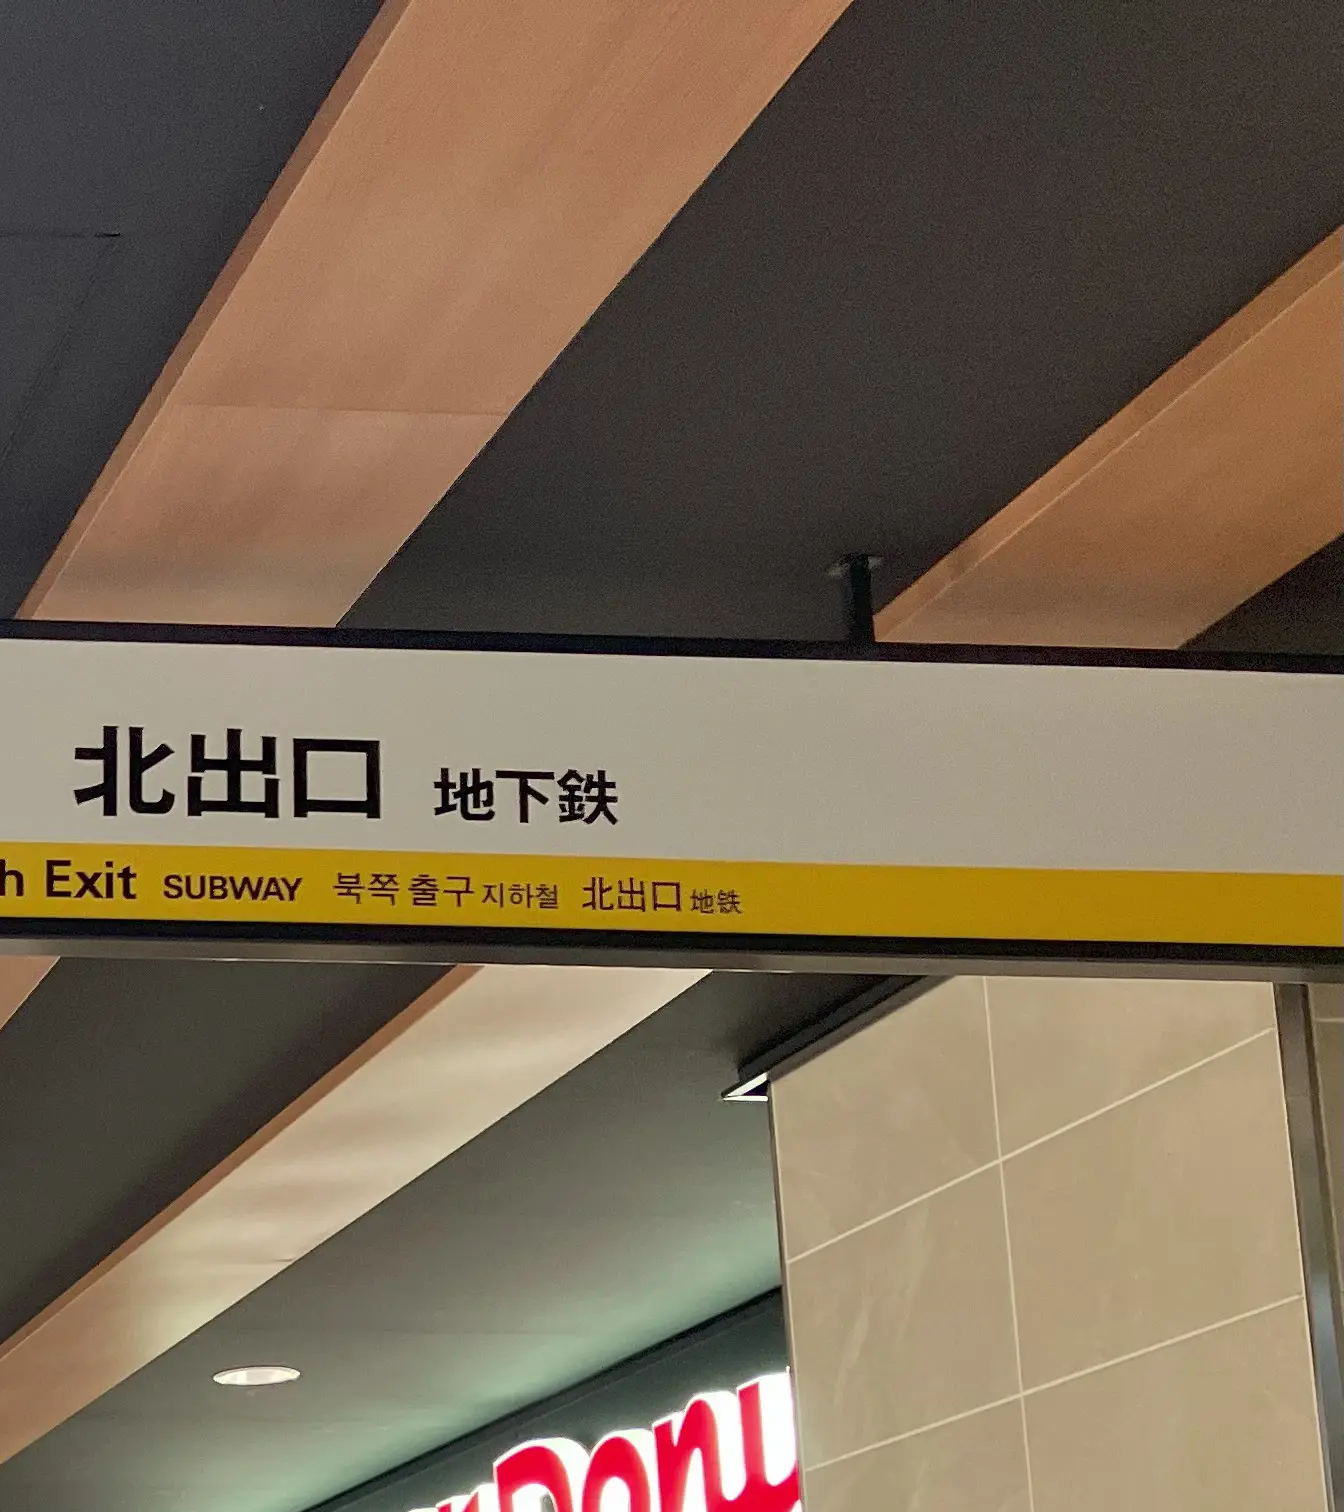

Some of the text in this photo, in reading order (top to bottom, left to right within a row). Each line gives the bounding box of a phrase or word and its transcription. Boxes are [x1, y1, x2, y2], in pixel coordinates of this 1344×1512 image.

[75, 725, 619, 826] 北出口 地下鉄
[45, 858, 138, 901] Exit
[163, 876, 303, 903] SUBWAY
[333, 872, 560, 912] 북쪽 출구 지하철
[582, 876, 743, 915] 北出口 地铁
